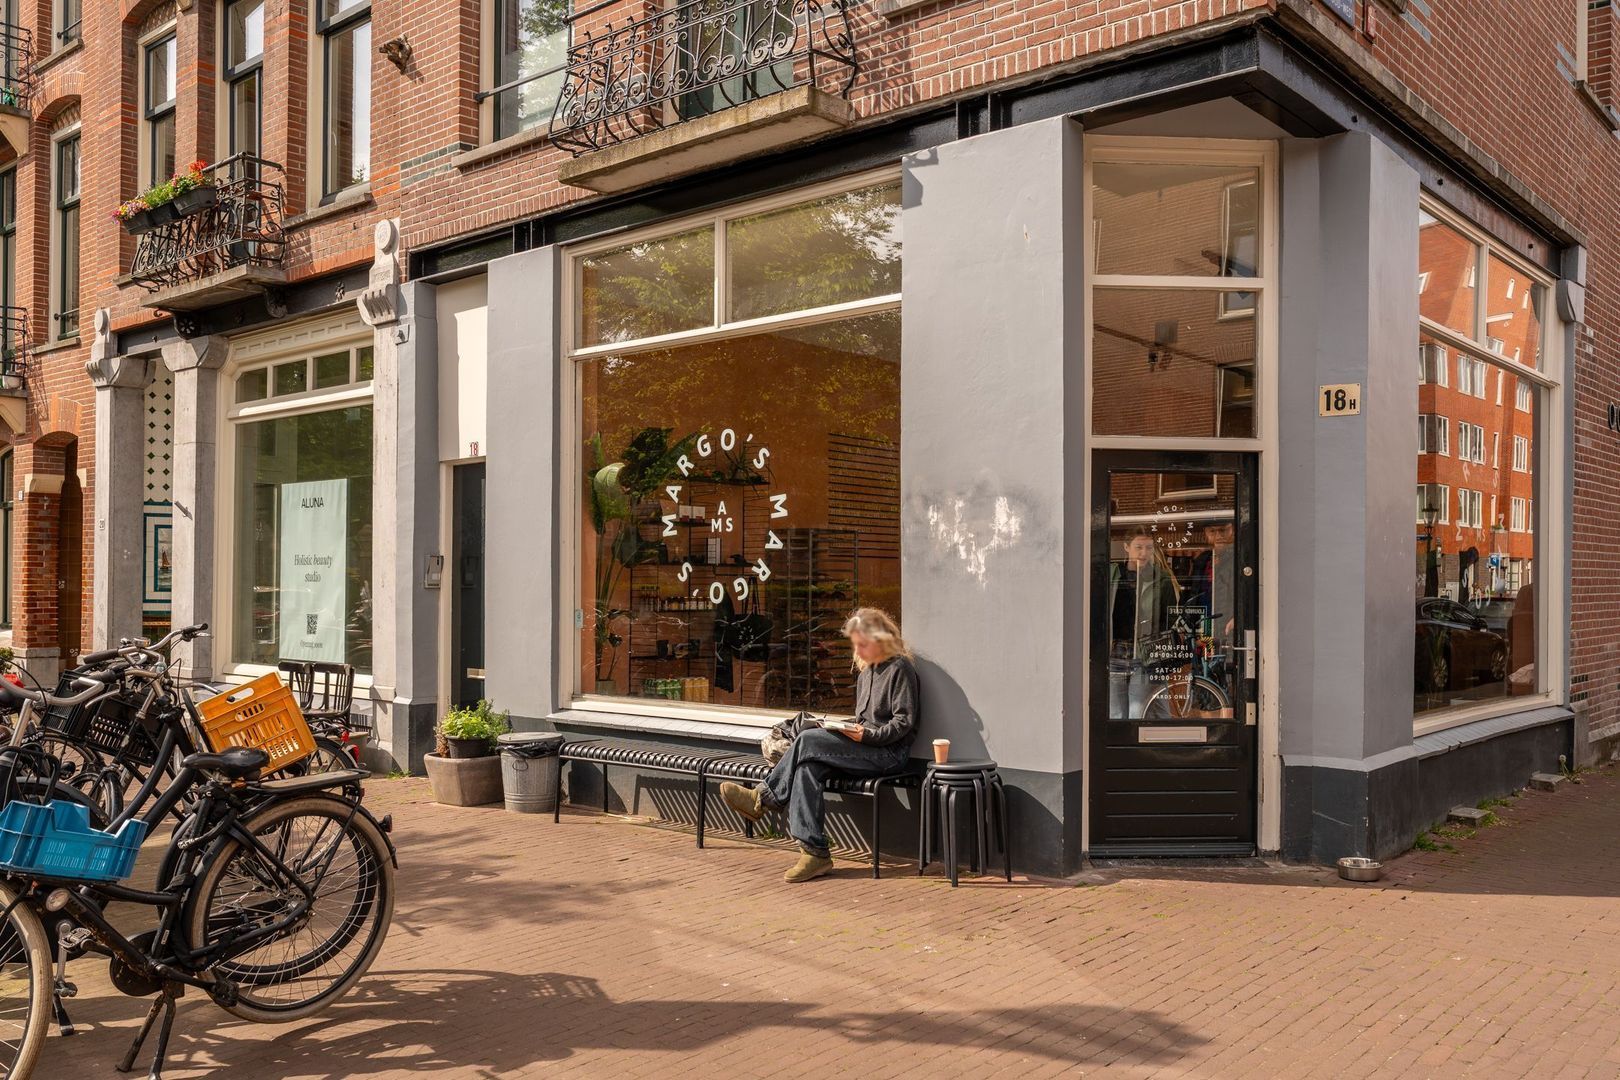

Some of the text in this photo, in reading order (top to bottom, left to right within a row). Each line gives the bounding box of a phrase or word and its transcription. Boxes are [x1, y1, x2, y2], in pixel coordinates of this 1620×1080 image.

[662, 428, 770, 537] MARGO'S
[301, 497, 324, 509] ALUNA
[717, 501, 727, 515] A
[711, 518, 733, 532] MS
[677, 493, 789, 604] MARGO'S
[294, 554, 333, 569] Holistic beauty
[304, 571, 322, 582] studio
